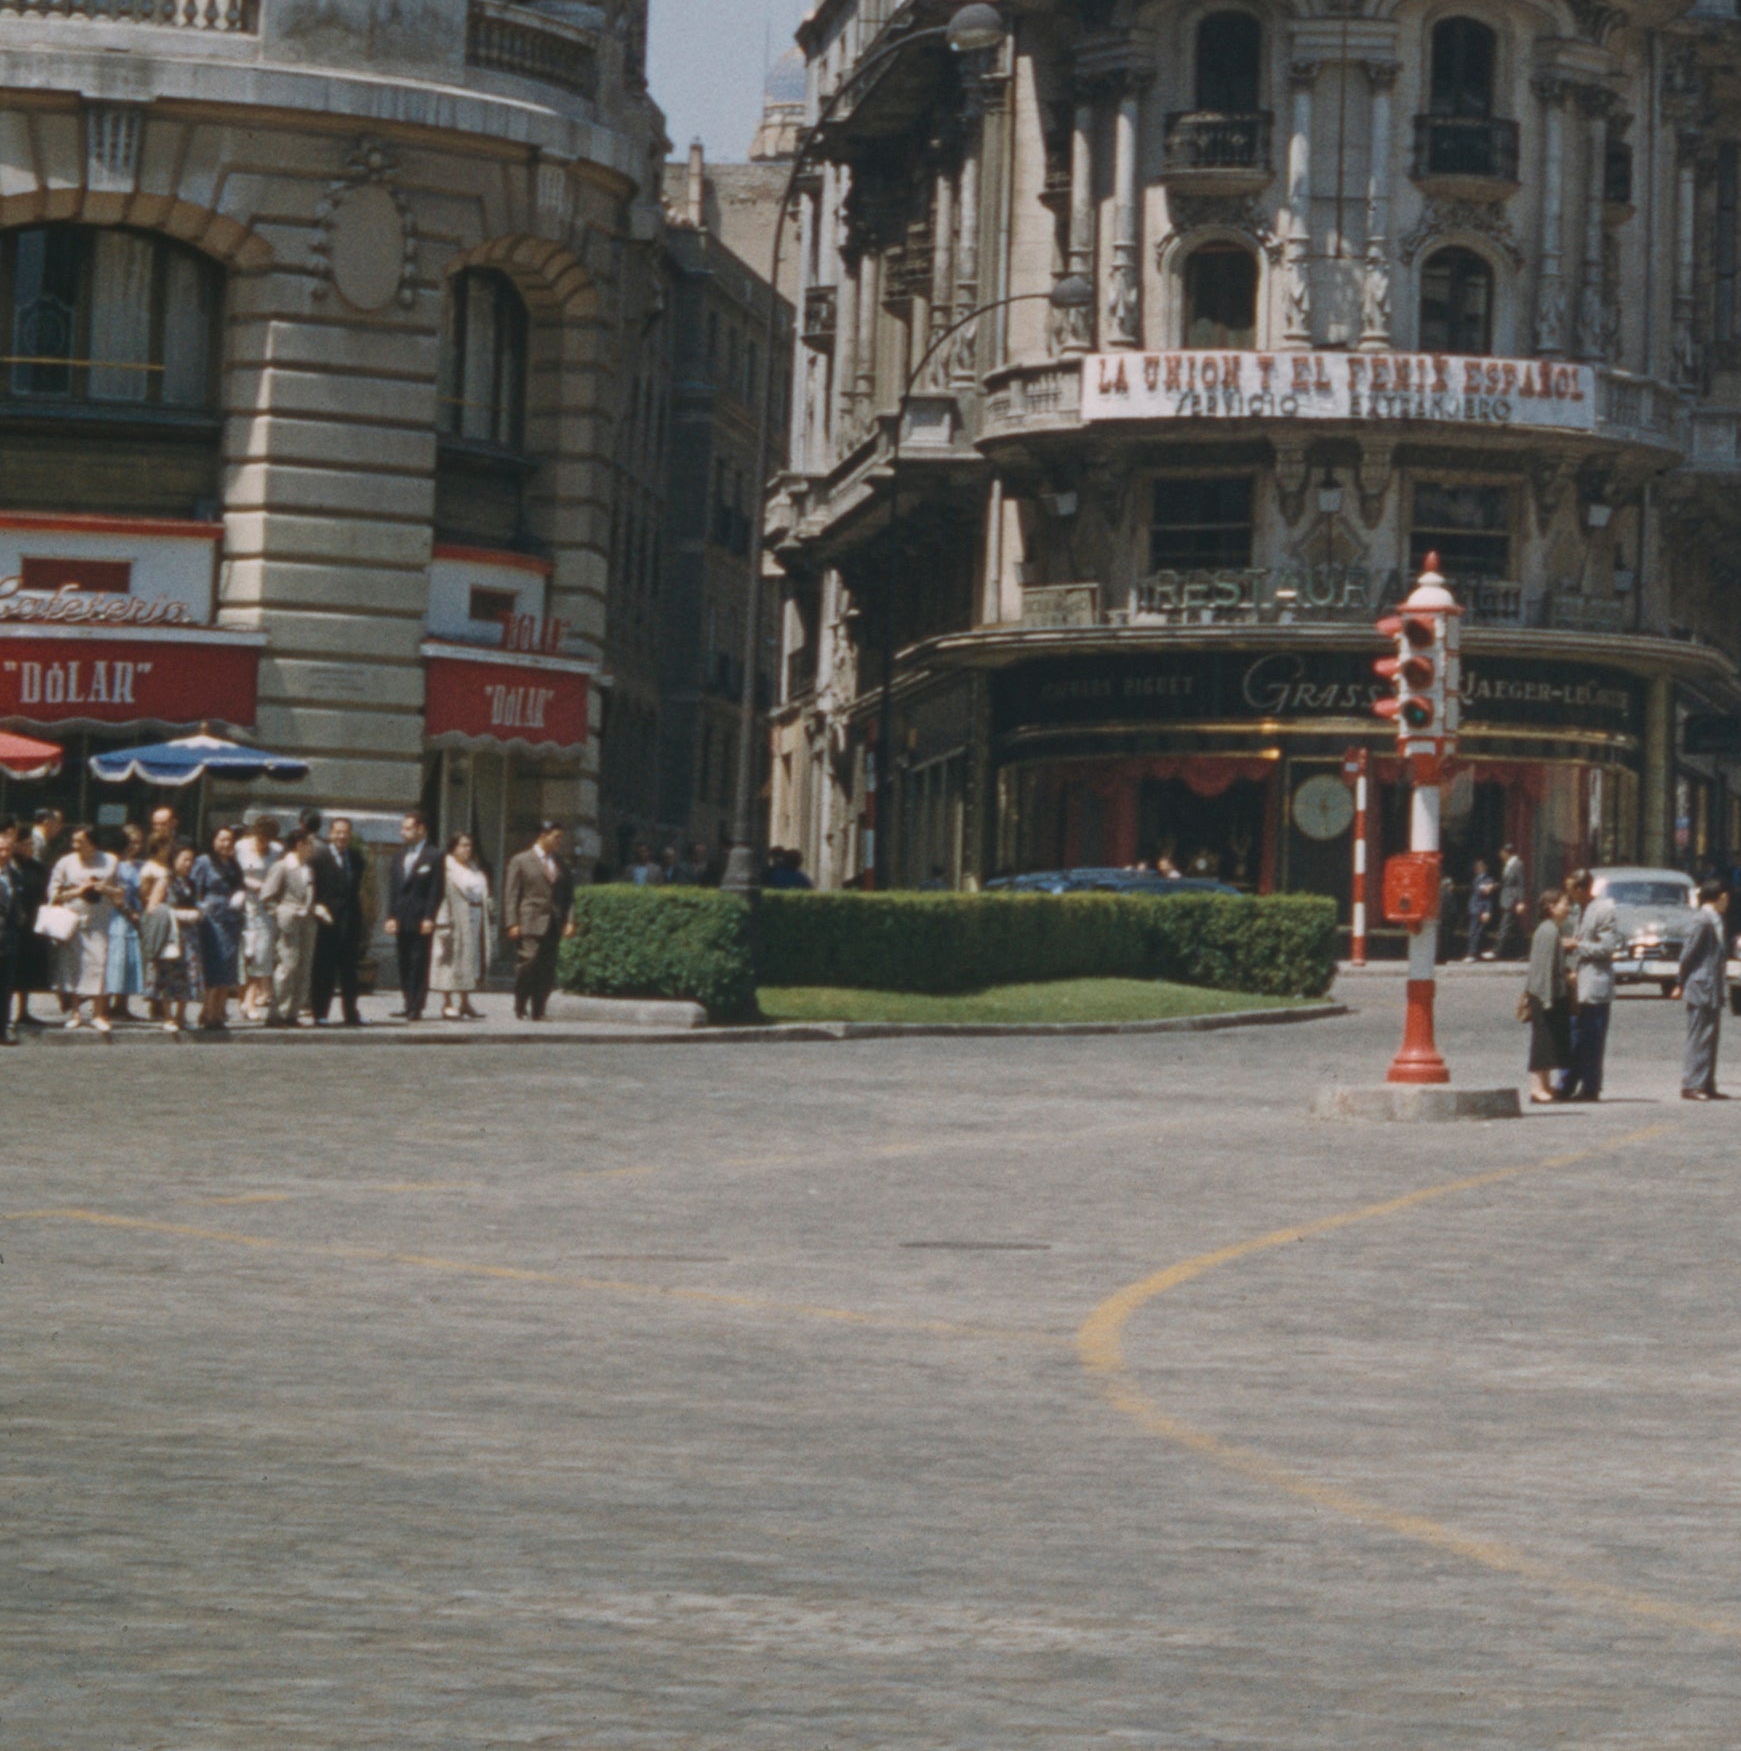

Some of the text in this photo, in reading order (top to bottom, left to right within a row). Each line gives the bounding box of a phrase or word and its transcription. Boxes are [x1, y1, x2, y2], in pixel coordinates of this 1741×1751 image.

[1098, 357, 1129, 394] LA
[1143, 355, 1241, 392] UNION
[1256, 355, 1275, 391] Y
[1291, 355, 1332, 392] EL
[1464, 358, 1584, 402] ESPAÑOL
[1241, 651, 1390, 713] GRASS
